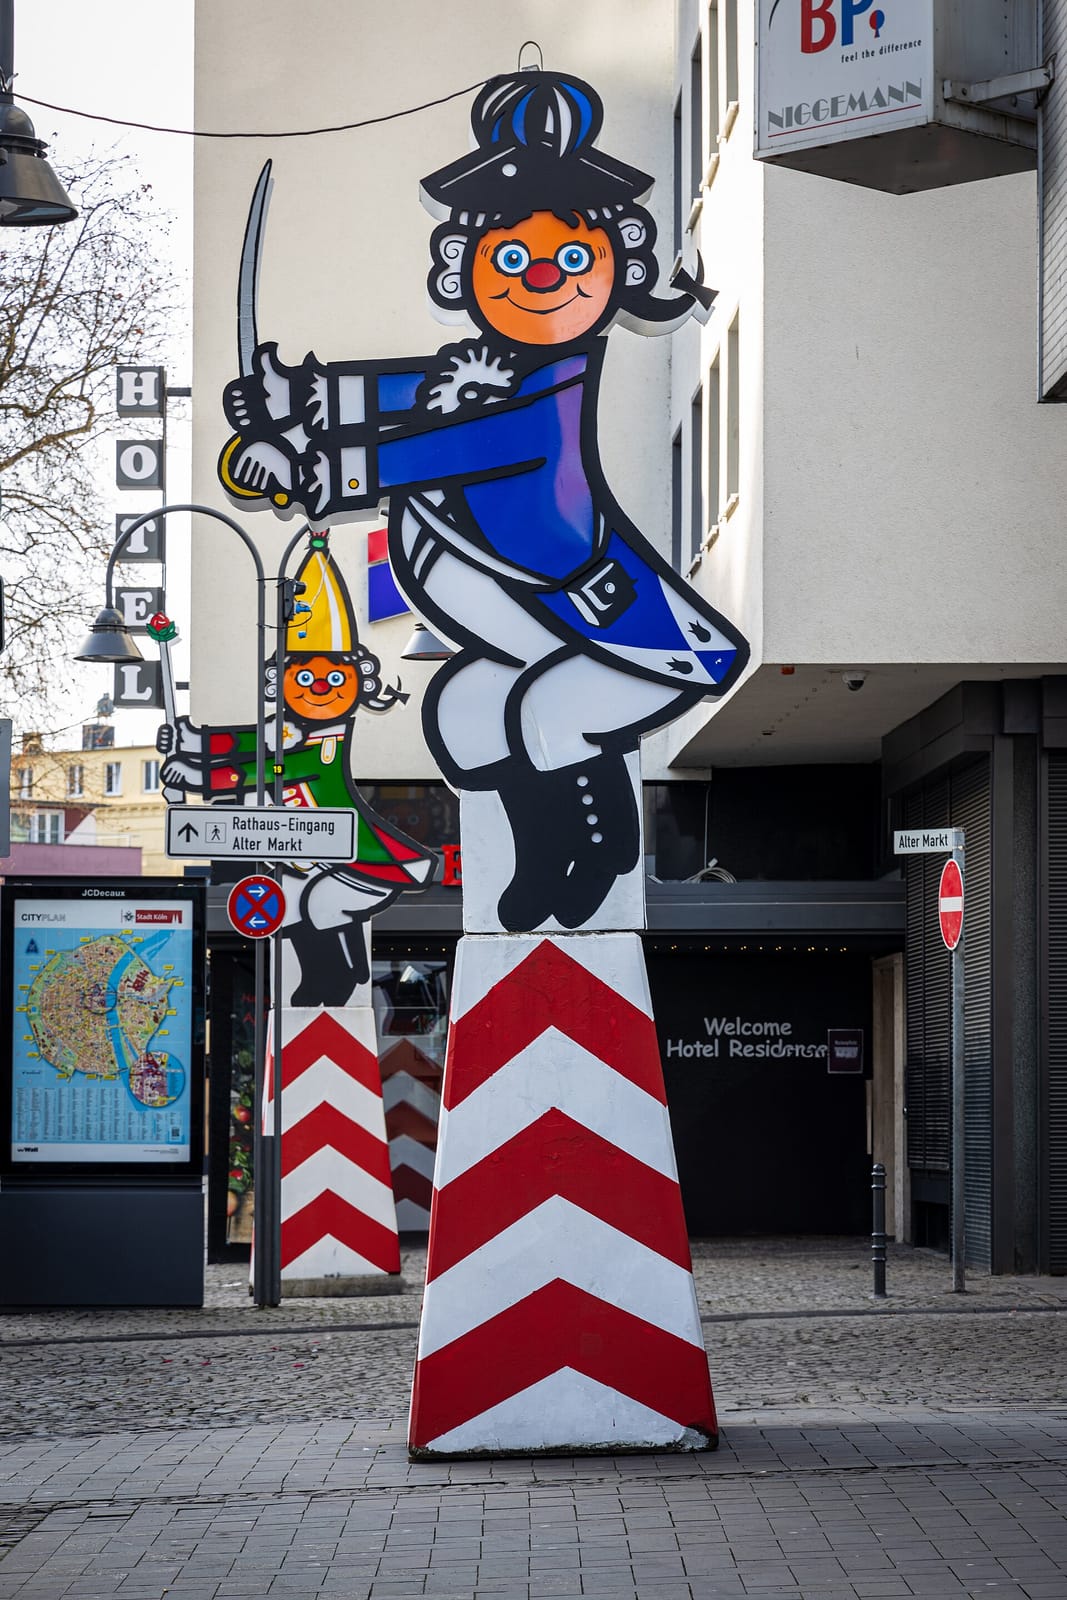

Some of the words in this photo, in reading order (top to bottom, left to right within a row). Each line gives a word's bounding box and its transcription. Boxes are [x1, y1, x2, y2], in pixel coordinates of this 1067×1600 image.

[841, 51, 858, 63] feel
[862, 49, 875, 59] the
[879, 40, 922, 56] difference
[768, 78, 922, 131] NIGGEMANN
[273, 765, 282, 774] 19
[232, 816, 335, 835] Rathaus-Eingang
[232, 837, 262, 851] Alter
[267, 838, 303, 851] Markt
[898, 835, 920, 848] Alter
[922, 833, 948, 847] Markt
[81, 888, 126, 897] JCDecaux
[153, 912, 168, 920] Köln
[703, 1016, 793, 1036] Welcome
[666, 1038, 719, 1058] Hotel
